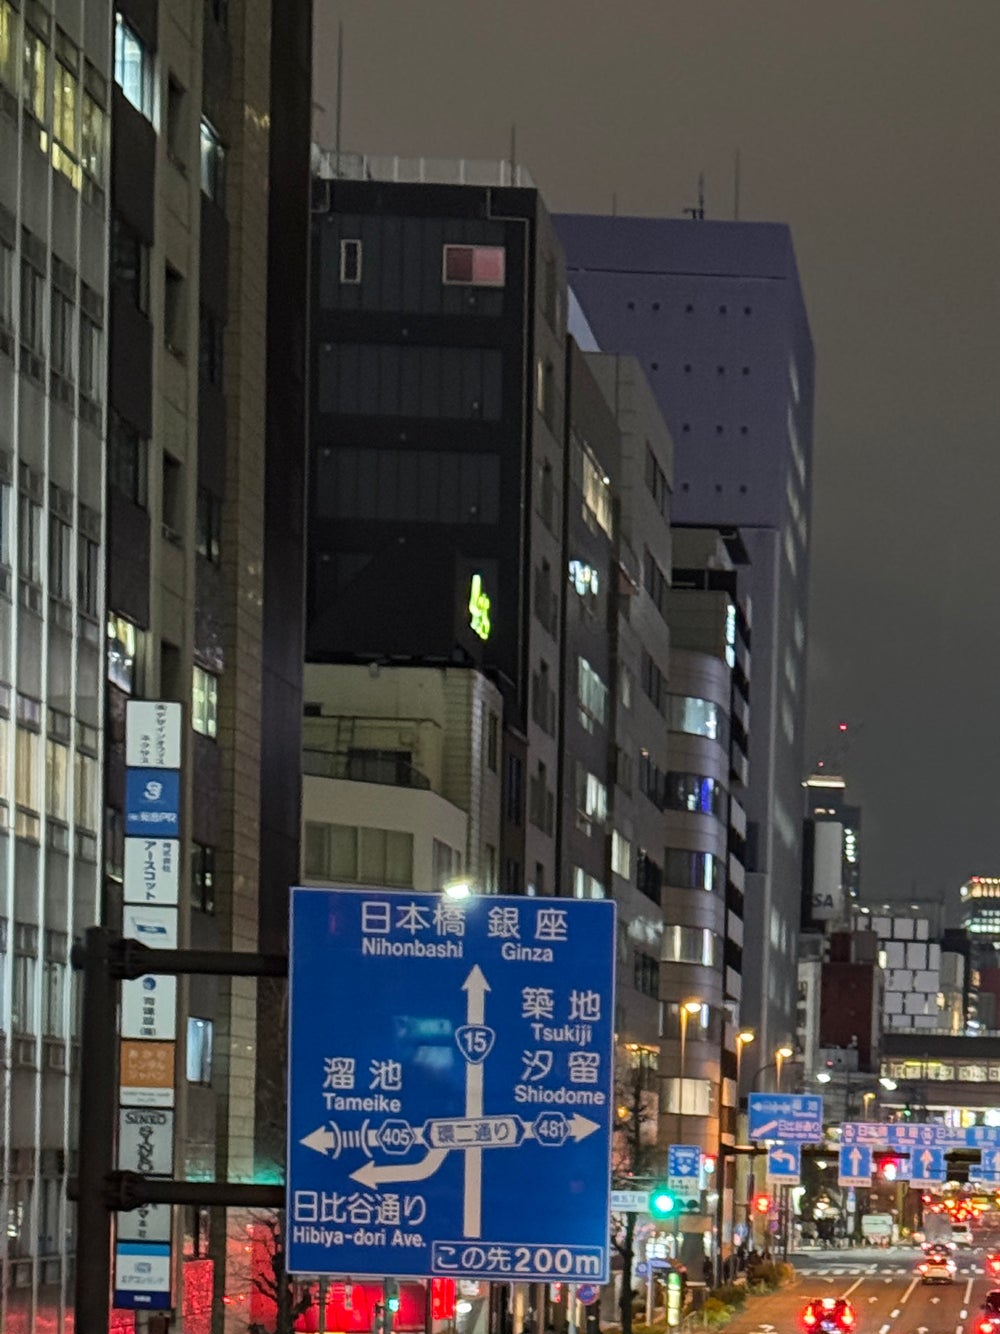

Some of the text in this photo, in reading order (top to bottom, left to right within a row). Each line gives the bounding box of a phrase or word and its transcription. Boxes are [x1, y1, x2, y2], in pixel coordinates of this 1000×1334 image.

[361, 901, 569, 942] 日本橋 銀座
[362, 938, 554, 963] Nihonbashi Ginza
[521, 986, 601, 1021] 築地
[464, 1031, 486, 1053] 15
[530, 1023, 592, 1047] Tsukiji
[322, 1057, 402, 1091] 溜池
[521, 1050, 599, 1084] 汐留
[323, 1093, 402, 1113] Tameike
[514, 1085, 606, 1106] Shiodome
[381, 1129, 410, 1147] 405
[538, 1121, 564, 1139] 481
[294, 1190, 427, 1226] 日比谷通り
[293, 1229, 427, 1248] Hibiya-dori Ave.
[436, 1246, 600, 1276] この先200m
